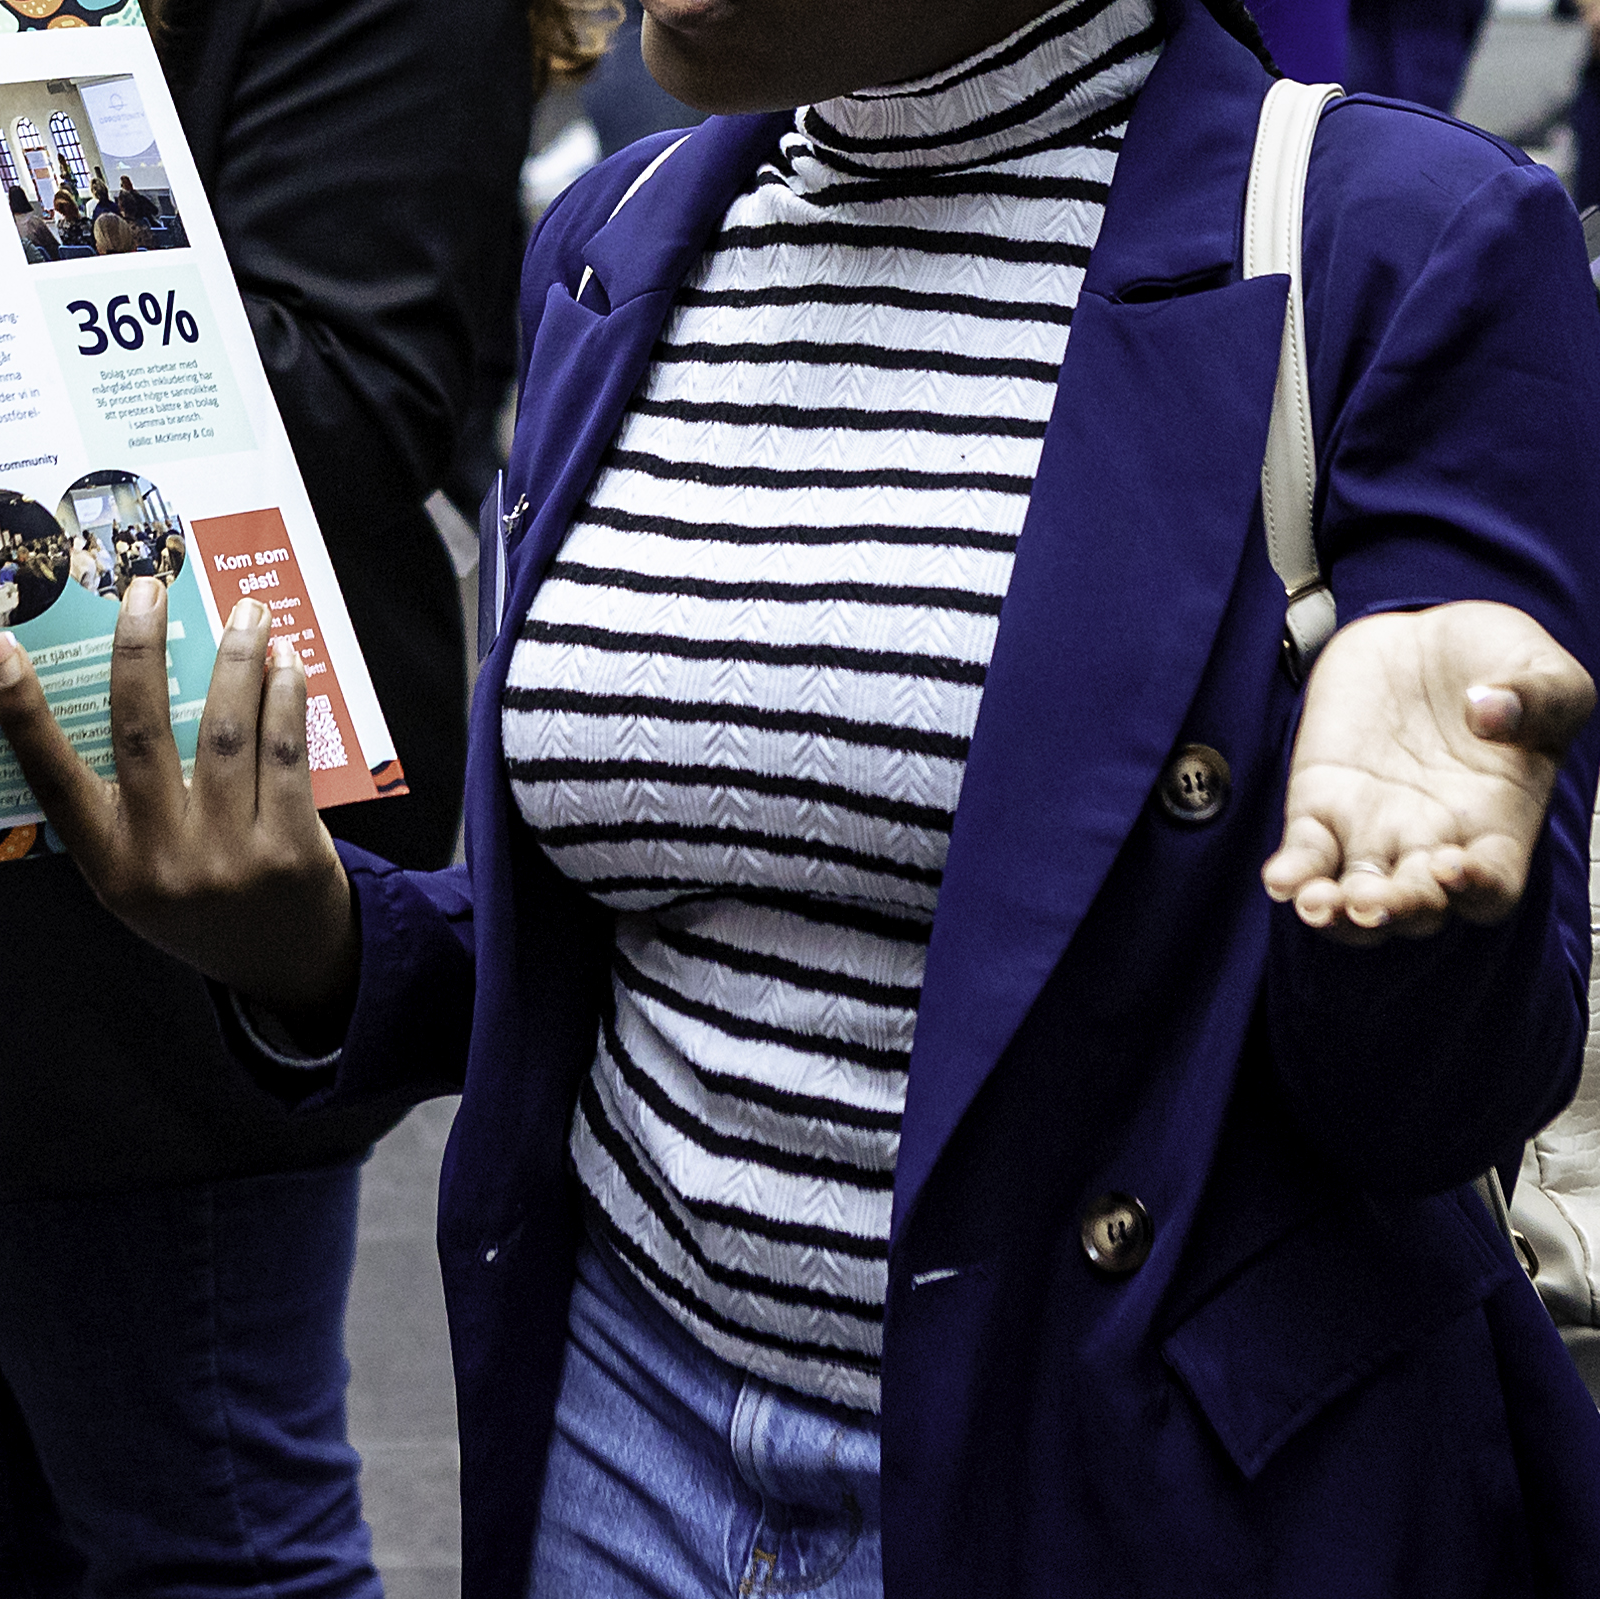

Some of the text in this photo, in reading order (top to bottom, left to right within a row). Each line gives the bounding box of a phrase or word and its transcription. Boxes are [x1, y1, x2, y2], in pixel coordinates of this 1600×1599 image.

[65, 289, 199, 355] 36%
[99, 359, 198, 380] Bolag som arbetar med
[91, 371, 212, 394] mångfald och inkludering har
[18, 391, 27, 399] vi
[30, 388, 39, 396] in
[108, 393, 142, 407] procent
[142, 390, 169, 402] högre
[169, 383, 217, 397] sannolikhet
[104, 410, 117, 420] att
[117, 405, 154, 419] prestera
[154, 402, 181, 412] bättre
[194, 397, 219, 408] bolag
[133, 417, 165, 429] samma
[165, 411, 203, 424] bransch.
[127, 436, 152, 448] (källa:
[154, 432, 191, 443] McKinsey
[200, 427, 214, 437] Co)
[213, 547, 289, 571] Kom som
[238, 569, 279, 594] gäst!
[268, 596, 301, 611] koden
[50, 645, 82, 666] tjäna!
[301, 647, 315, 659] en
